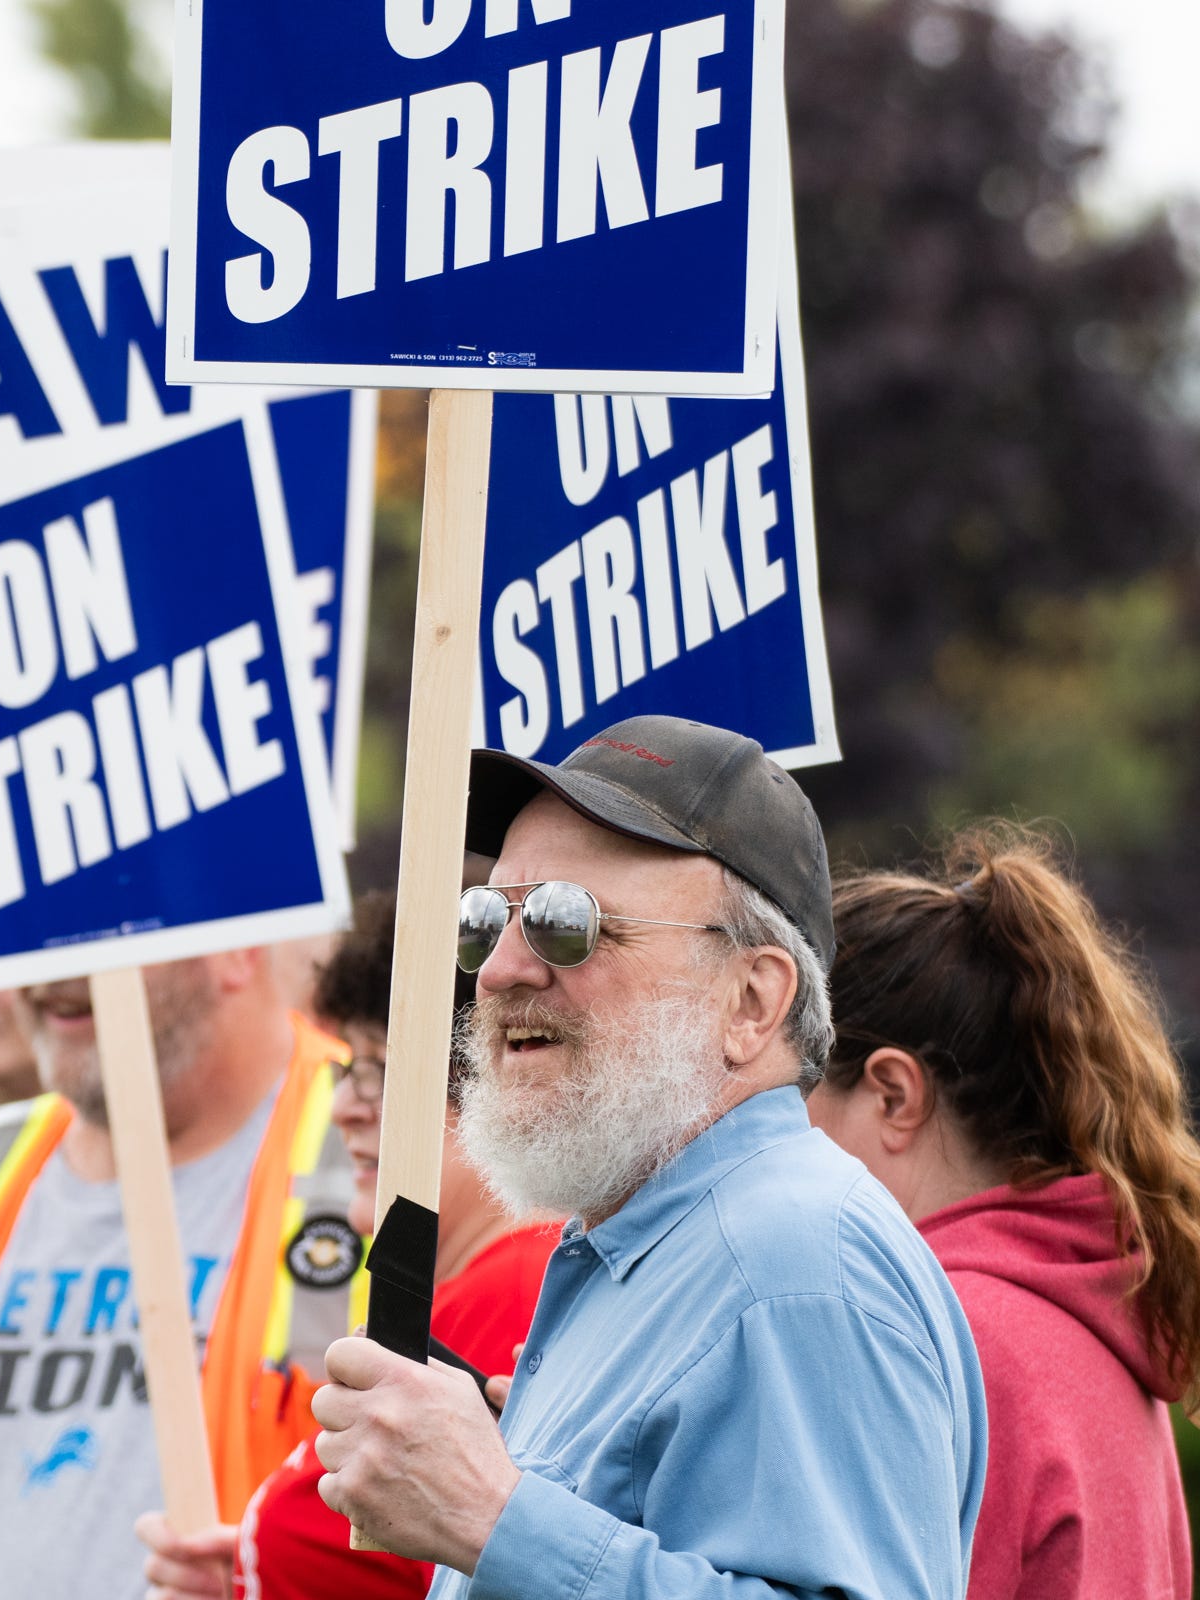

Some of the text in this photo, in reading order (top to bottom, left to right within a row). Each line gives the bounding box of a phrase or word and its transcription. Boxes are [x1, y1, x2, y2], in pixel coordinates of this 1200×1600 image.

[225, 14, 726, 323] STRIKE
[390, 353, 416, 361] SAWICKI
[417, 353, 422, 361] &
[492, 422, 786, 773] STRIKE
